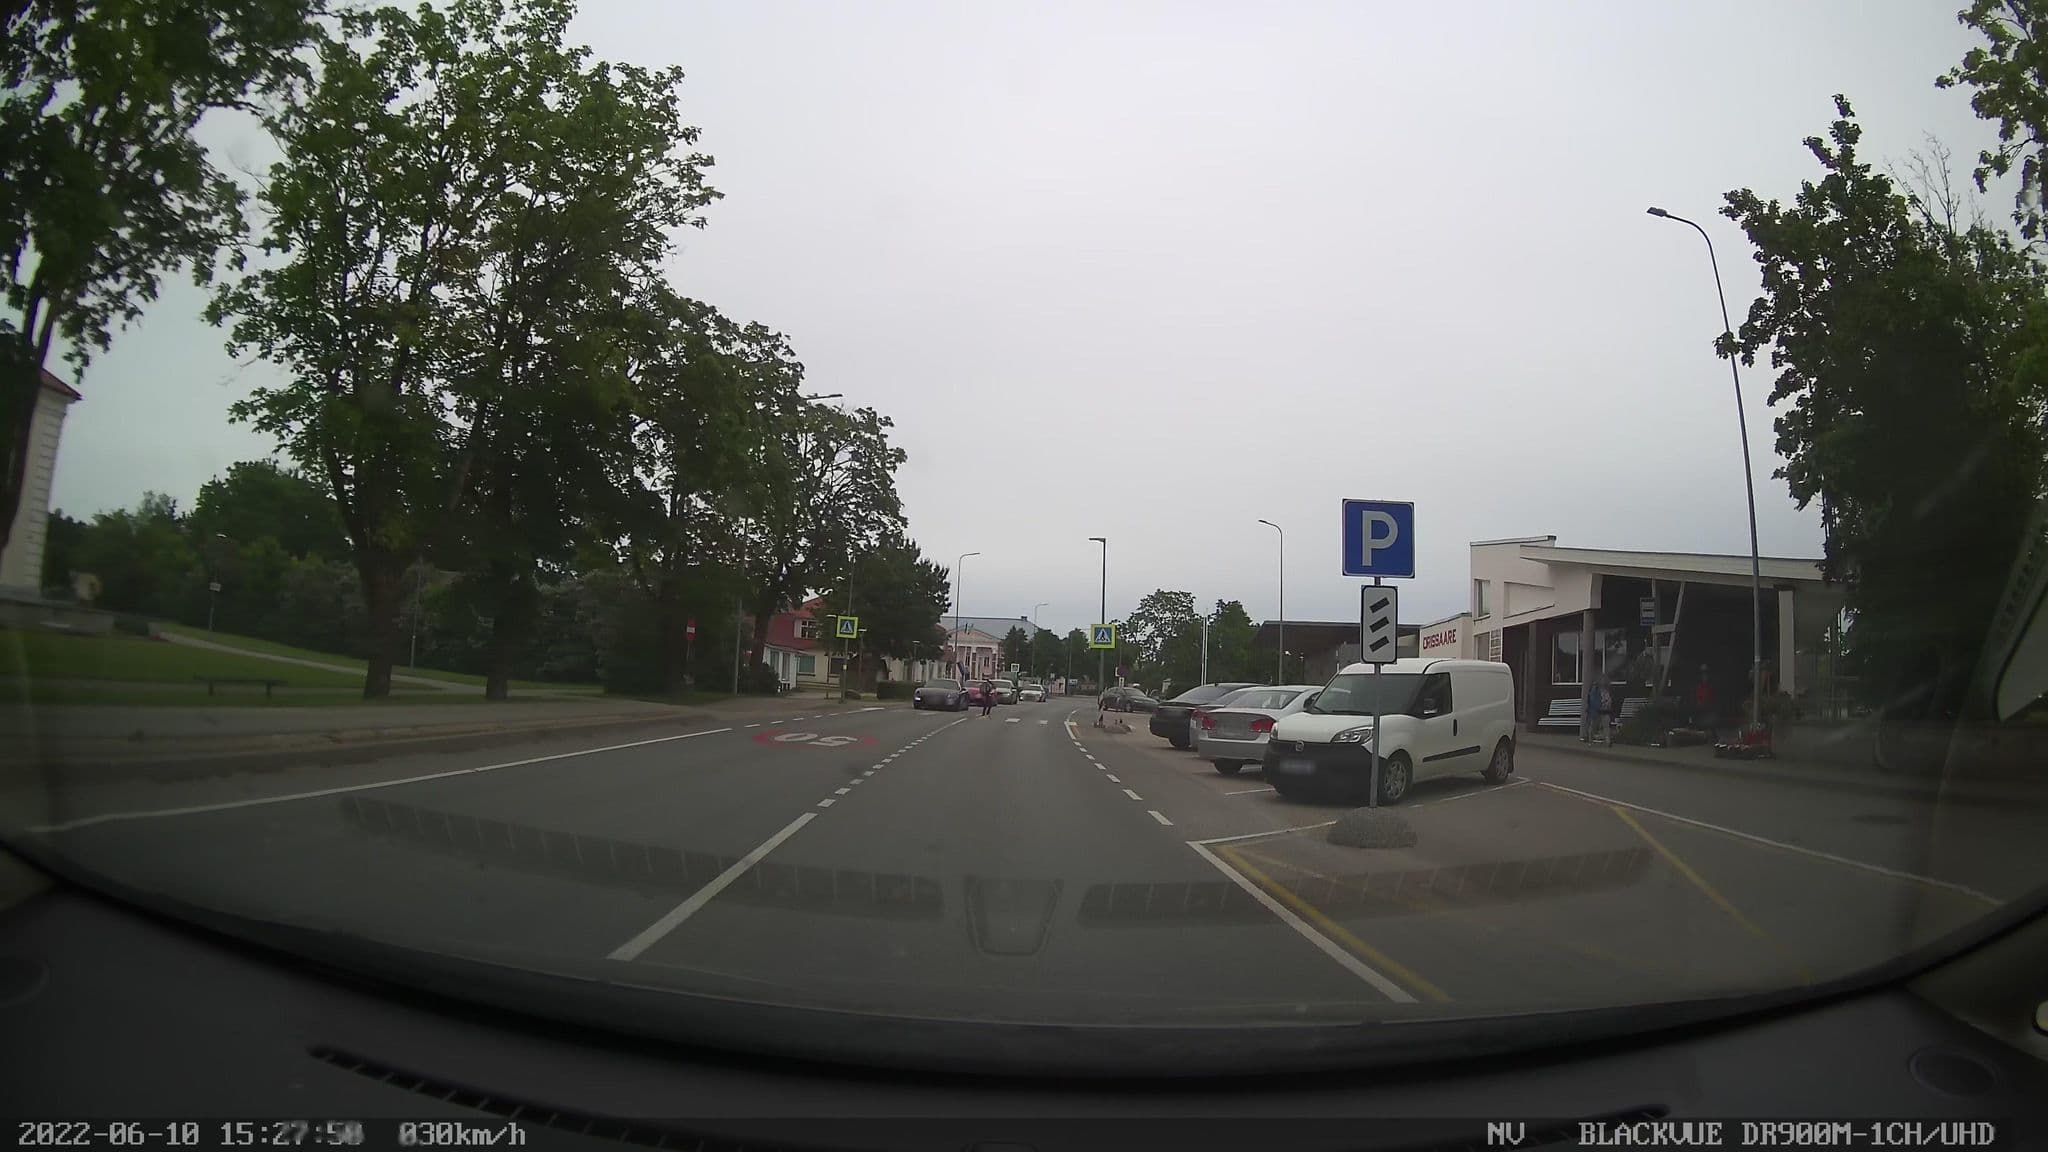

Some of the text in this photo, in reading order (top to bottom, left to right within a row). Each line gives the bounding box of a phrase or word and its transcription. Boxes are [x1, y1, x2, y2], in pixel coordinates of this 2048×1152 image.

[1362, 510, 1398, 566] P
[1423, 629, 1456, 649] ORISSAARE
[774, 733, 857, 746] 50
